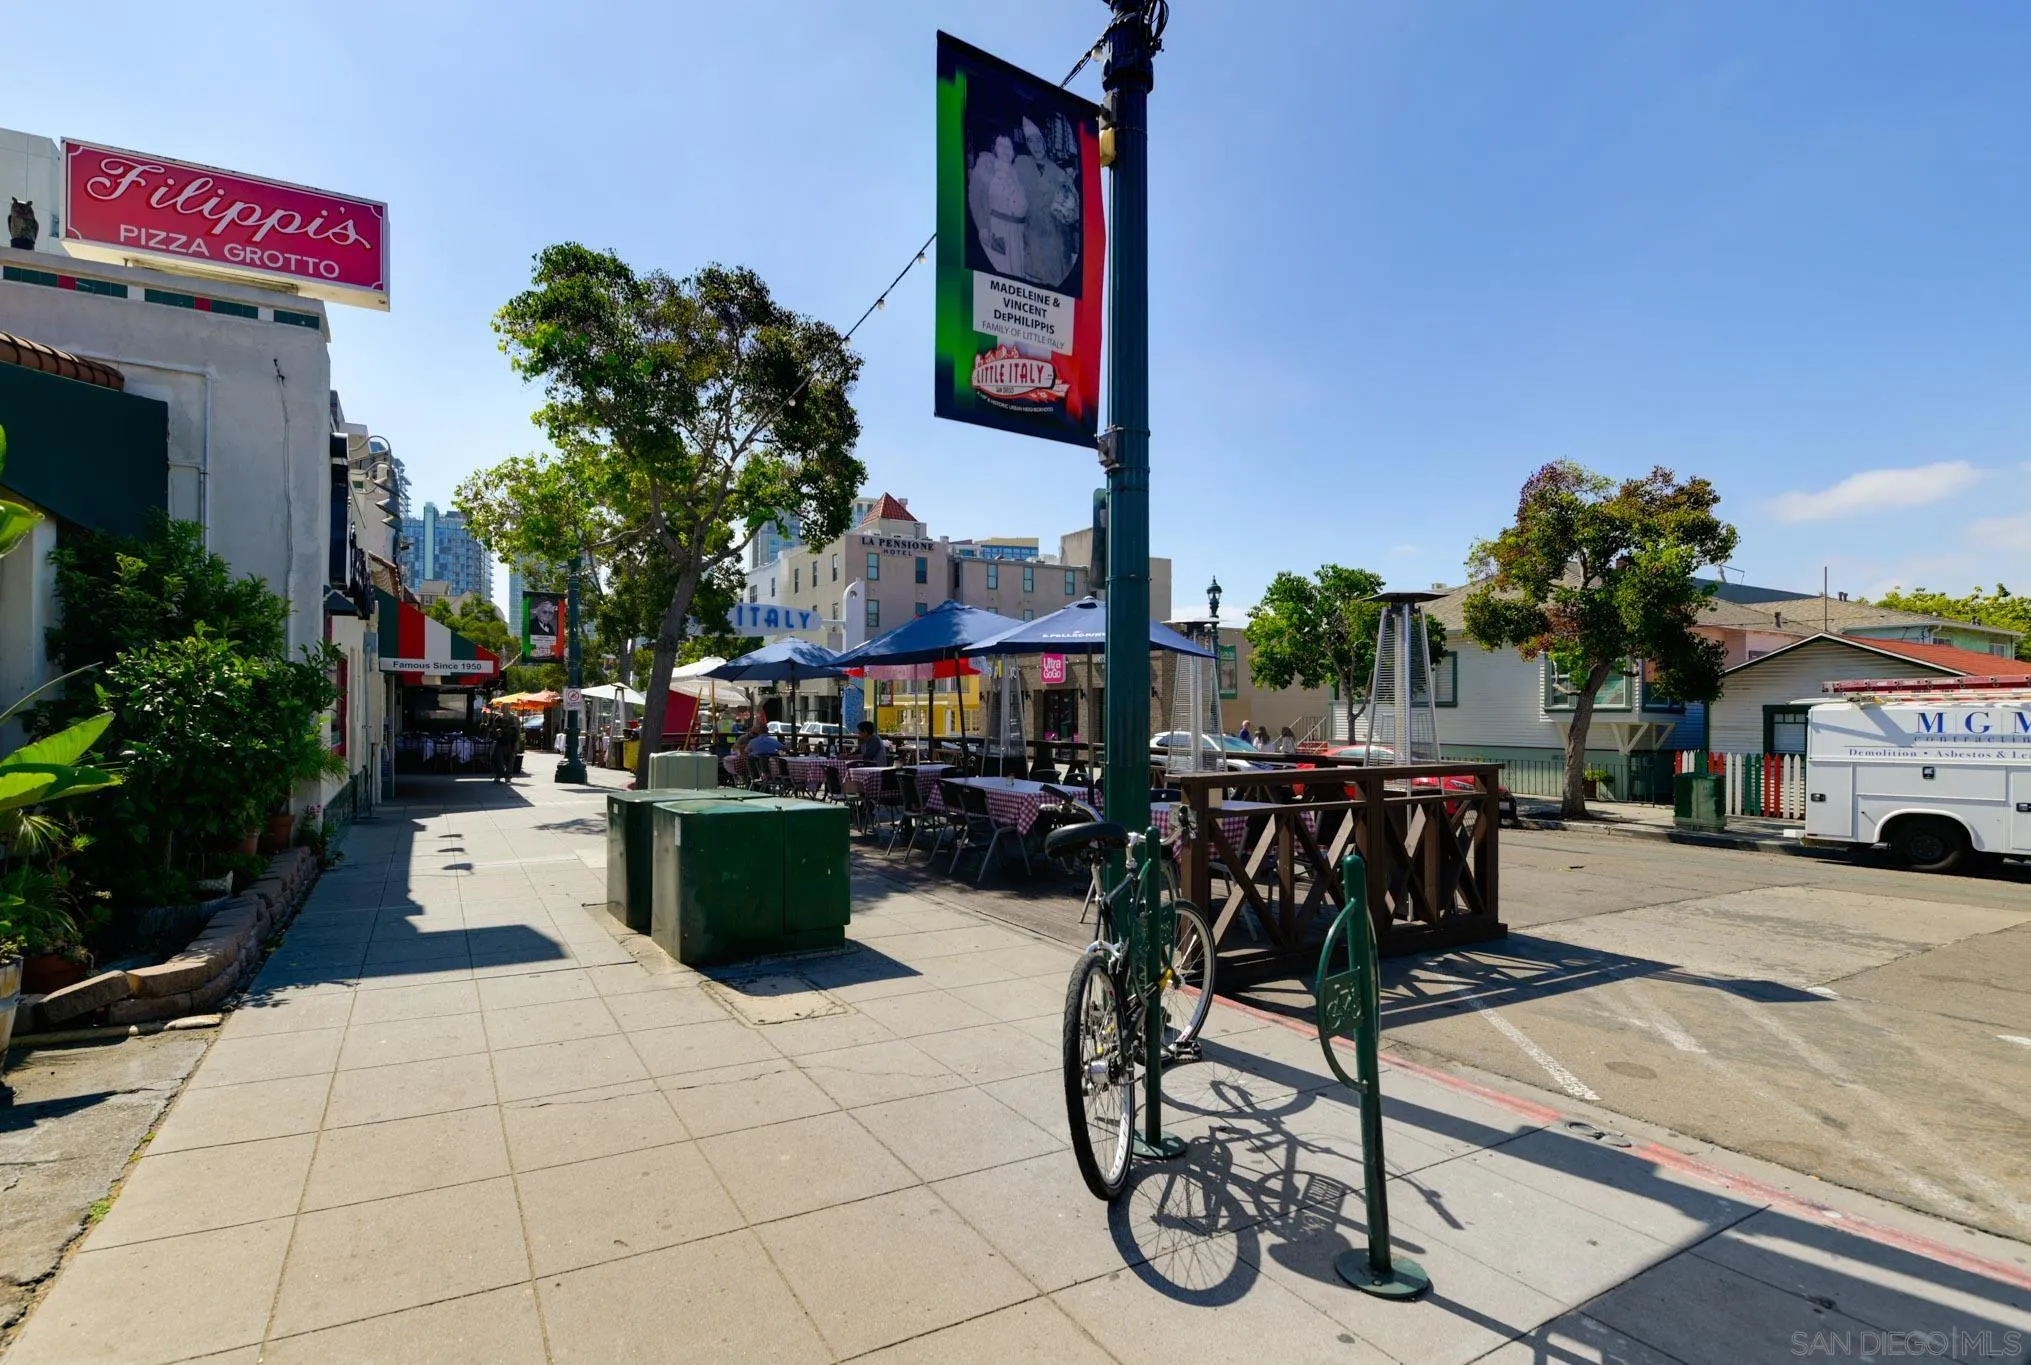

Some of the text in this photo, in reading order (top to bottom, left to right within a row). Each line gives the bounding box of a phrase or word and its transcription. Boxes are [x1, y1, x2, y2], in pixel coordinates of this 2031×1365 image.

[87, 158, 371, 249] Filippi's
[120, 224, 341, 278] PIZZA GROTTO
[990, 280, 1060, 307] MADELEINE &
[1003, 297, 1047, 318] VINCENT
[982, 320, 1065, 350] FAMILY OF LITTLE ITALY
[977, 362, 1044, 385] LITTLE ITALY
[862, 536, 934, 551] LA PENSIONE
[883, 549, 912, 557] HOTEL
[737, 605, 810, 629] ITALY
[393, 661, 430, 669] Famous
[433, 662, 458, 670] Since
[1043, 657, 1061, 669] Ultra
[1043, 669, 1061, 679] GoGo
[1849, 749, 1917, 757] Demolition
[1936, 750, 1991, 758] Asbestos
[1996, 751, 2005, 759] &
